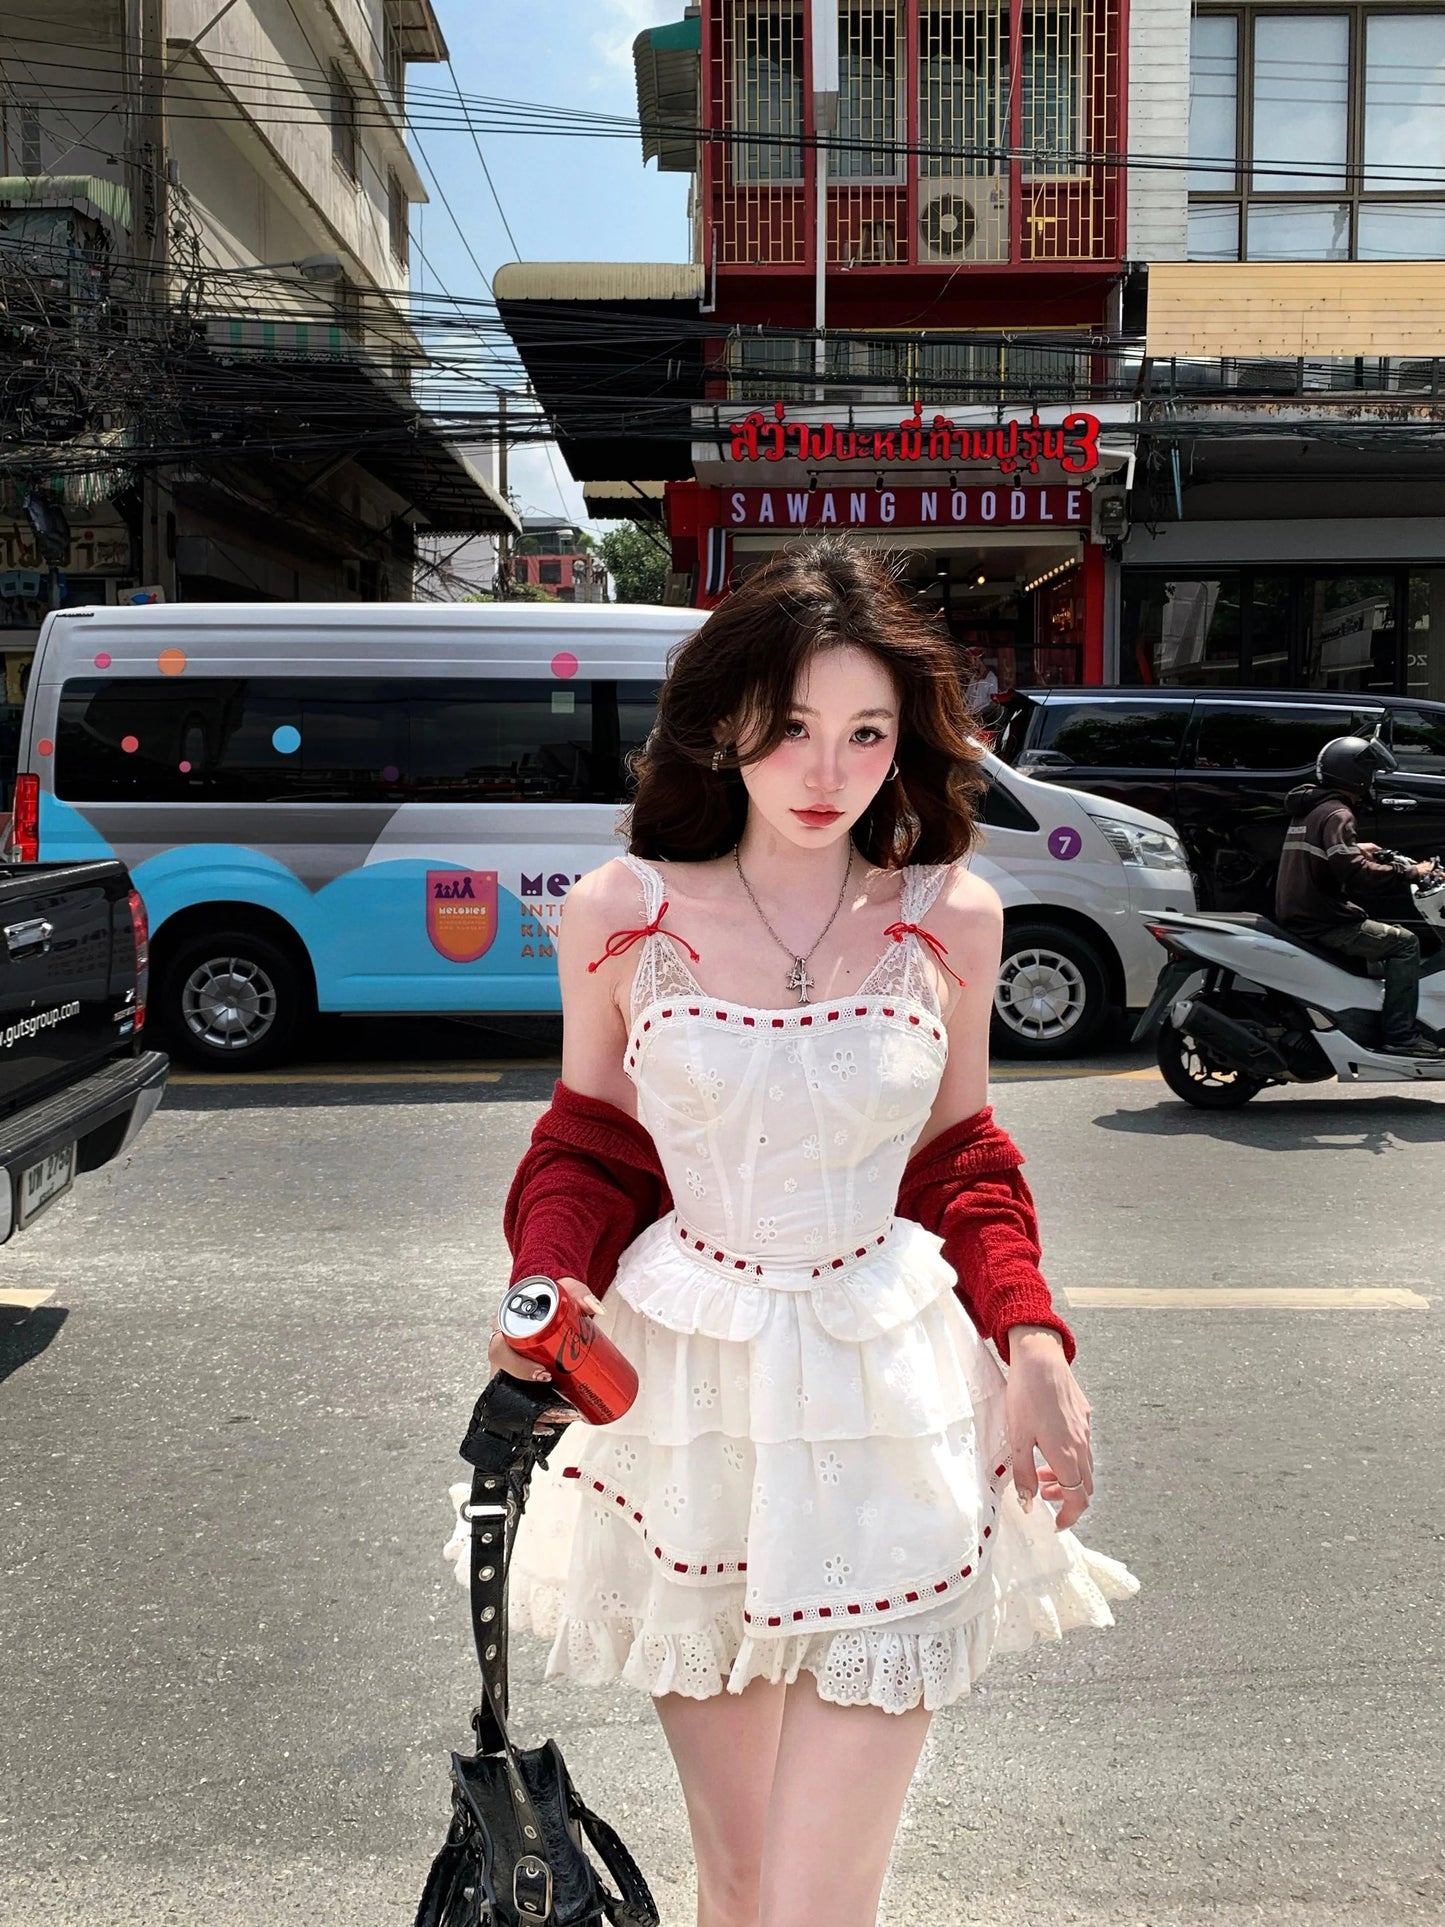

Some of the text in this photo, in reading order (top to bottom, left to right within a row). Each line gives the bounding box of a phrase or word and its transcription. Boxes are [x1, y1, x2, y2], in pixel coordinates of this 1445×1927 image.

[731, 490, 1081, 523] SAWANG NOODLE
[1058, 836, 1072, 854] 7
